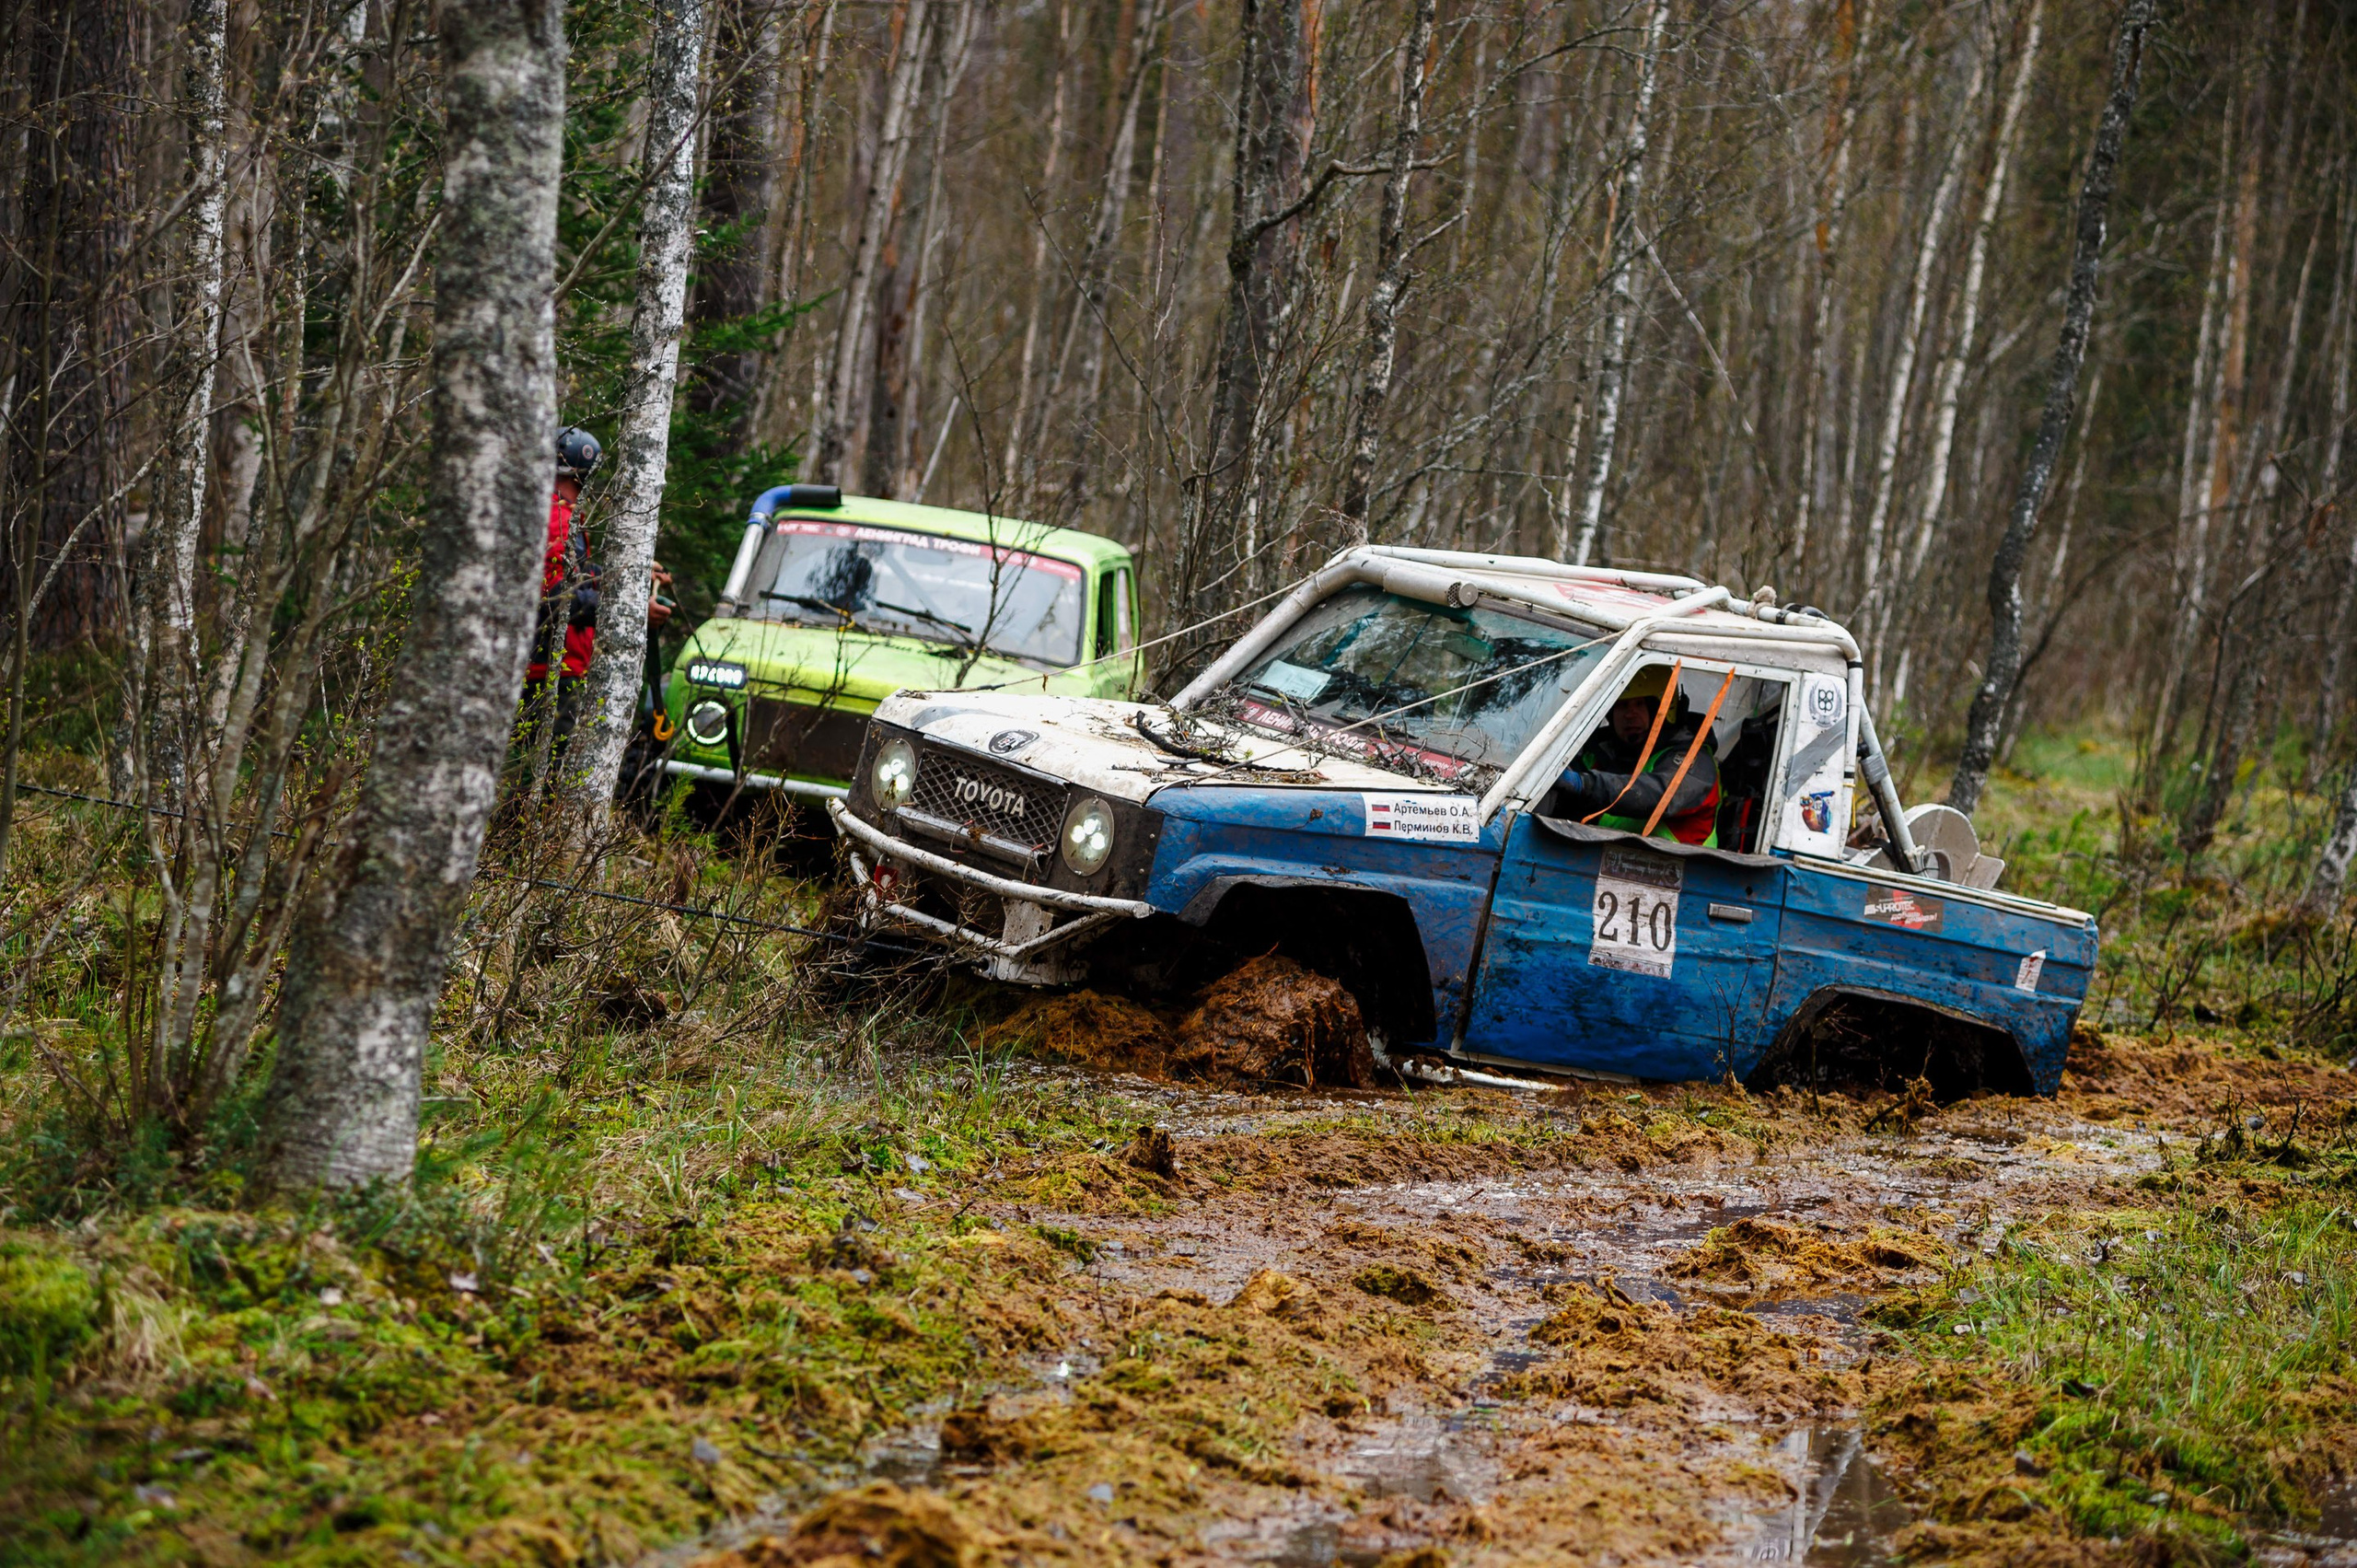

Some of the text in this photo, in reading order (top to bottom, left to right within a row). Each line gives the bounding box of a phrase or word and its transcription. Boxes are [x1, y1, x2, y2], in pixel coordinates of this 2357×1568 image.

[853, 527, 981, 557] ЛЕНИНГРАД ТРОФИ
[1257, 710, 1323, 740] ЛЕНИНАД
[954, 776, 1025, 818] TOYOTA
[1394, 803, 1447, 817] Артемьев
[1394, 819, 1449, 834] Перминов
[1597, 890, 1672, 951] 210
[1875, 900, 1915, 913] SUPROTEC
